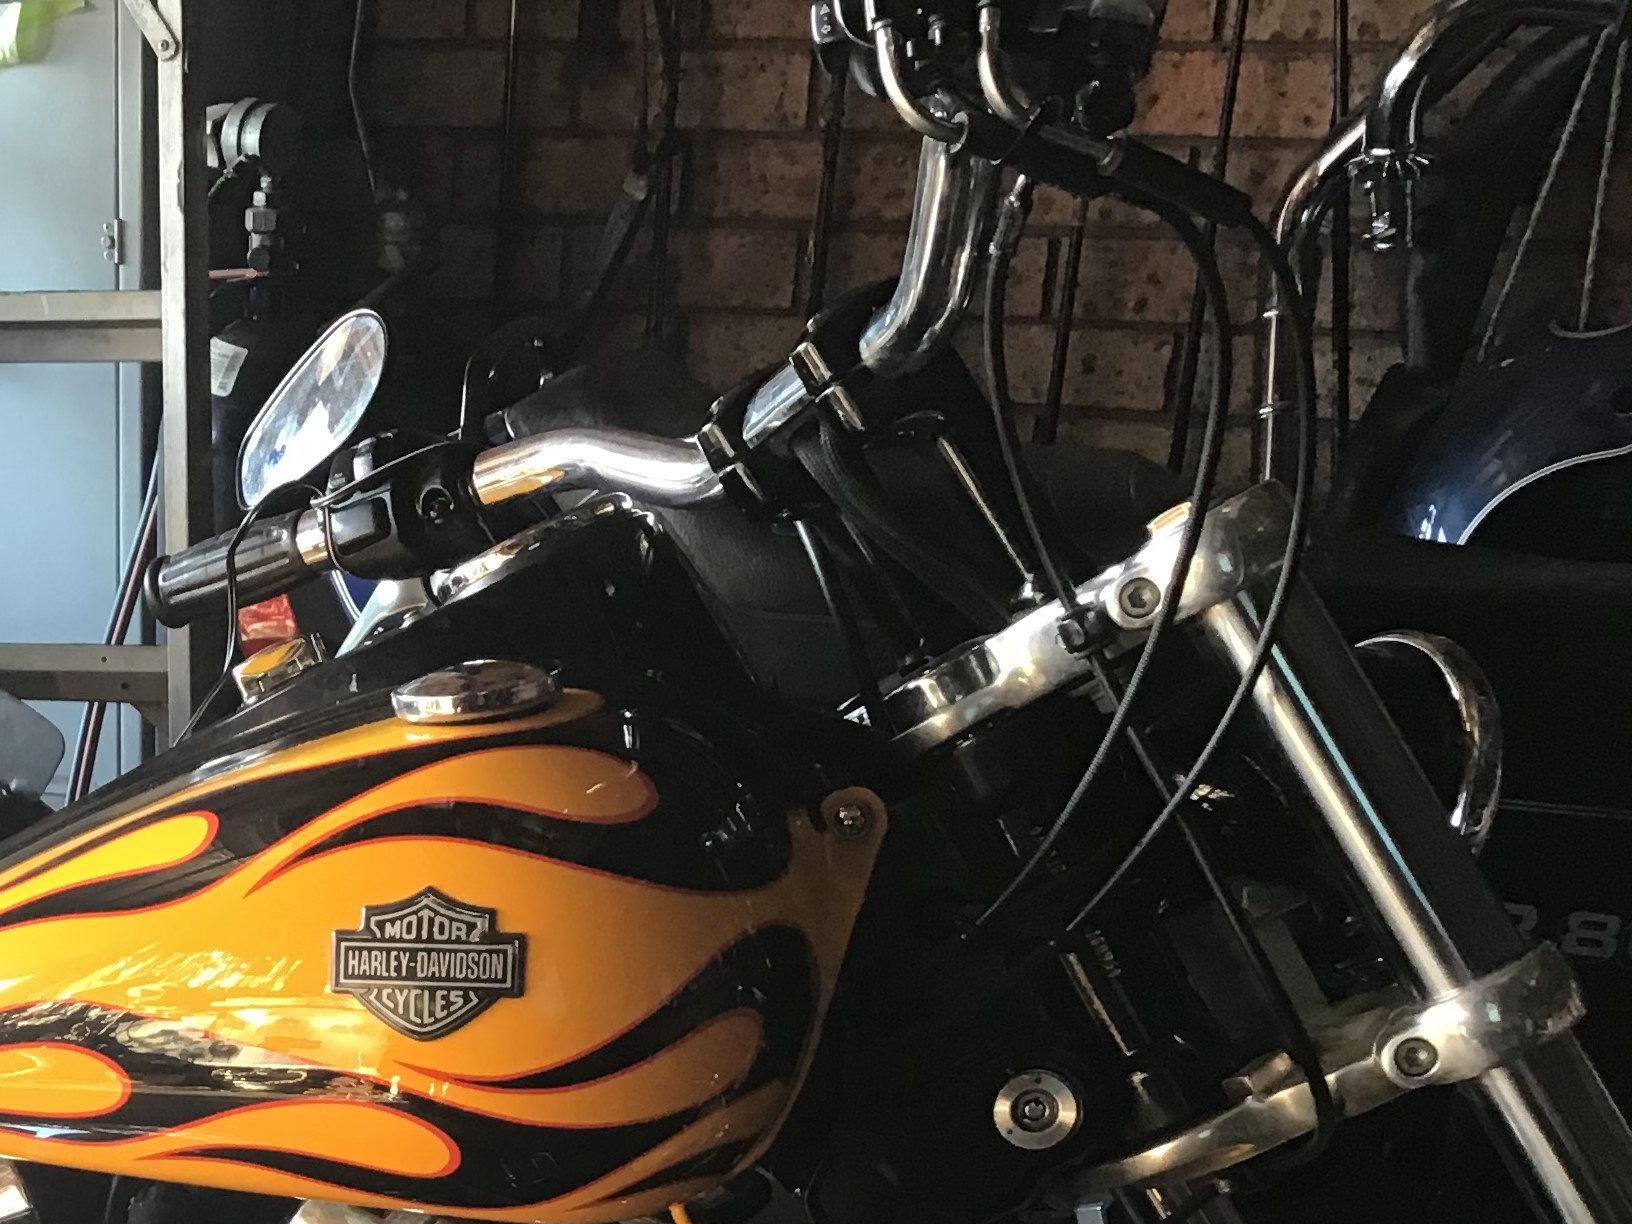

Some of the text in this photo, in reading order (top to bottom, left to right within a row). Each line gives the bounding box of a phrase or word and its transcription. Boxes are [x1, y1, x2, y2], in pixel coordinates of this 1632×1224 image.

[384, 908, 468, 941] MOTOR
[347, 949, 504, 980] HARLEY-DAVIDSON
[381, 987, 464, 1025] CYCLES
